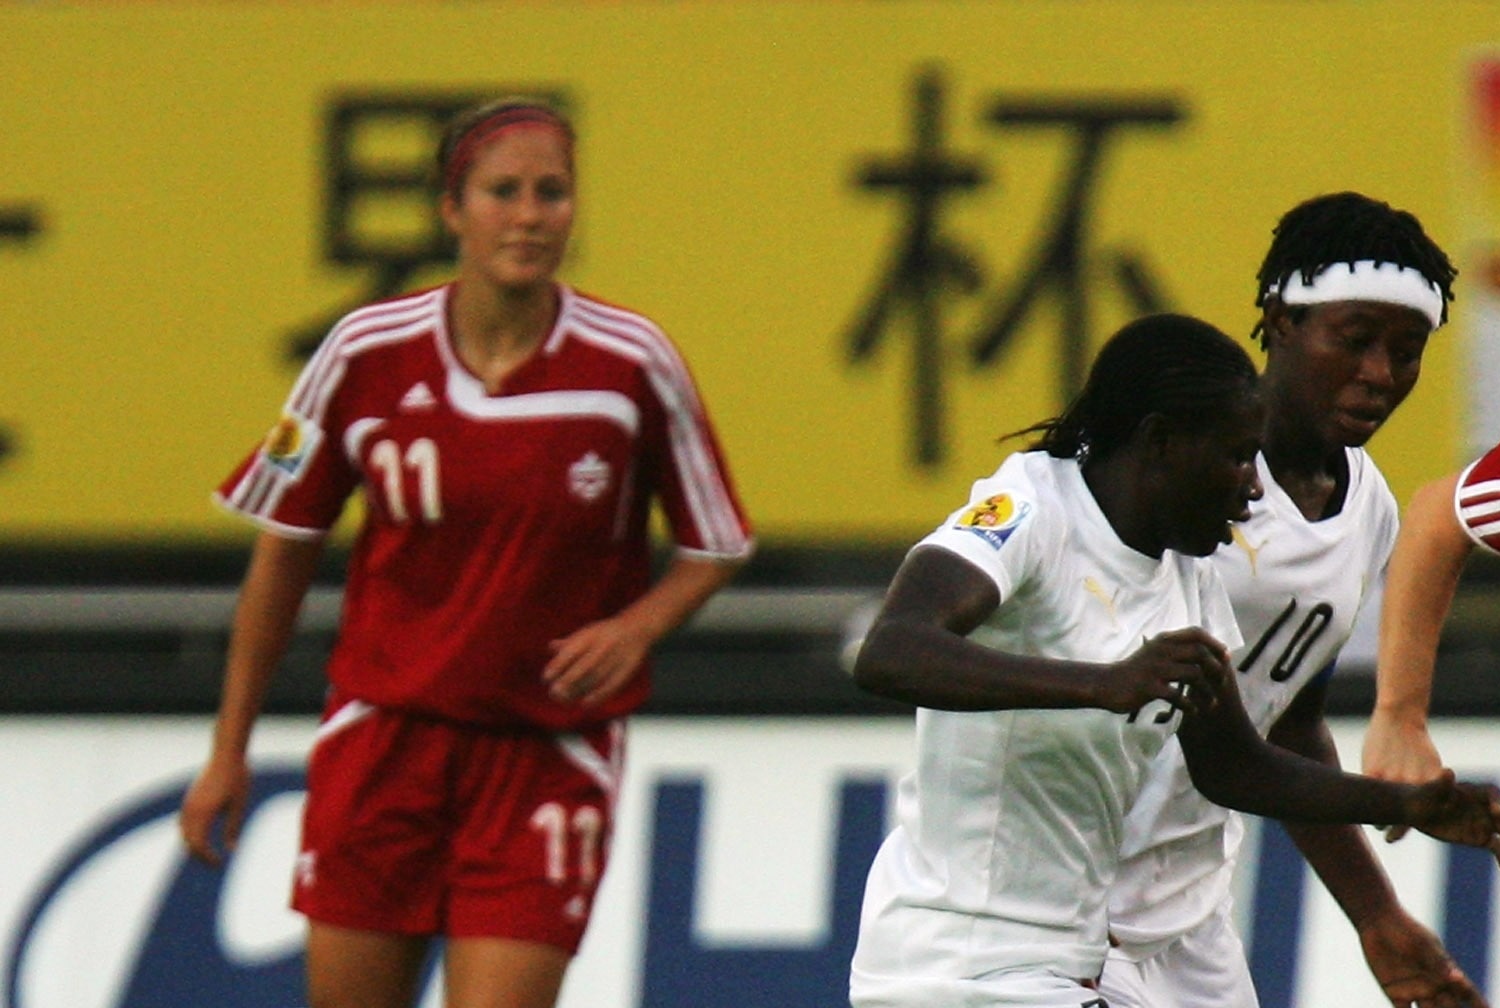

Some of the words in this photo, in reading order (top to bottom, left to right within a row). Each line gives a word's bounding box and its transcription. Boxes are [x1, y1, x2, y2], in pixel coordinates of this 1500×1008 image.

[370, 437, 443, 523] 11
[1237, 597, 1334, 682] 10
[530, 801, 600, 882] 11
